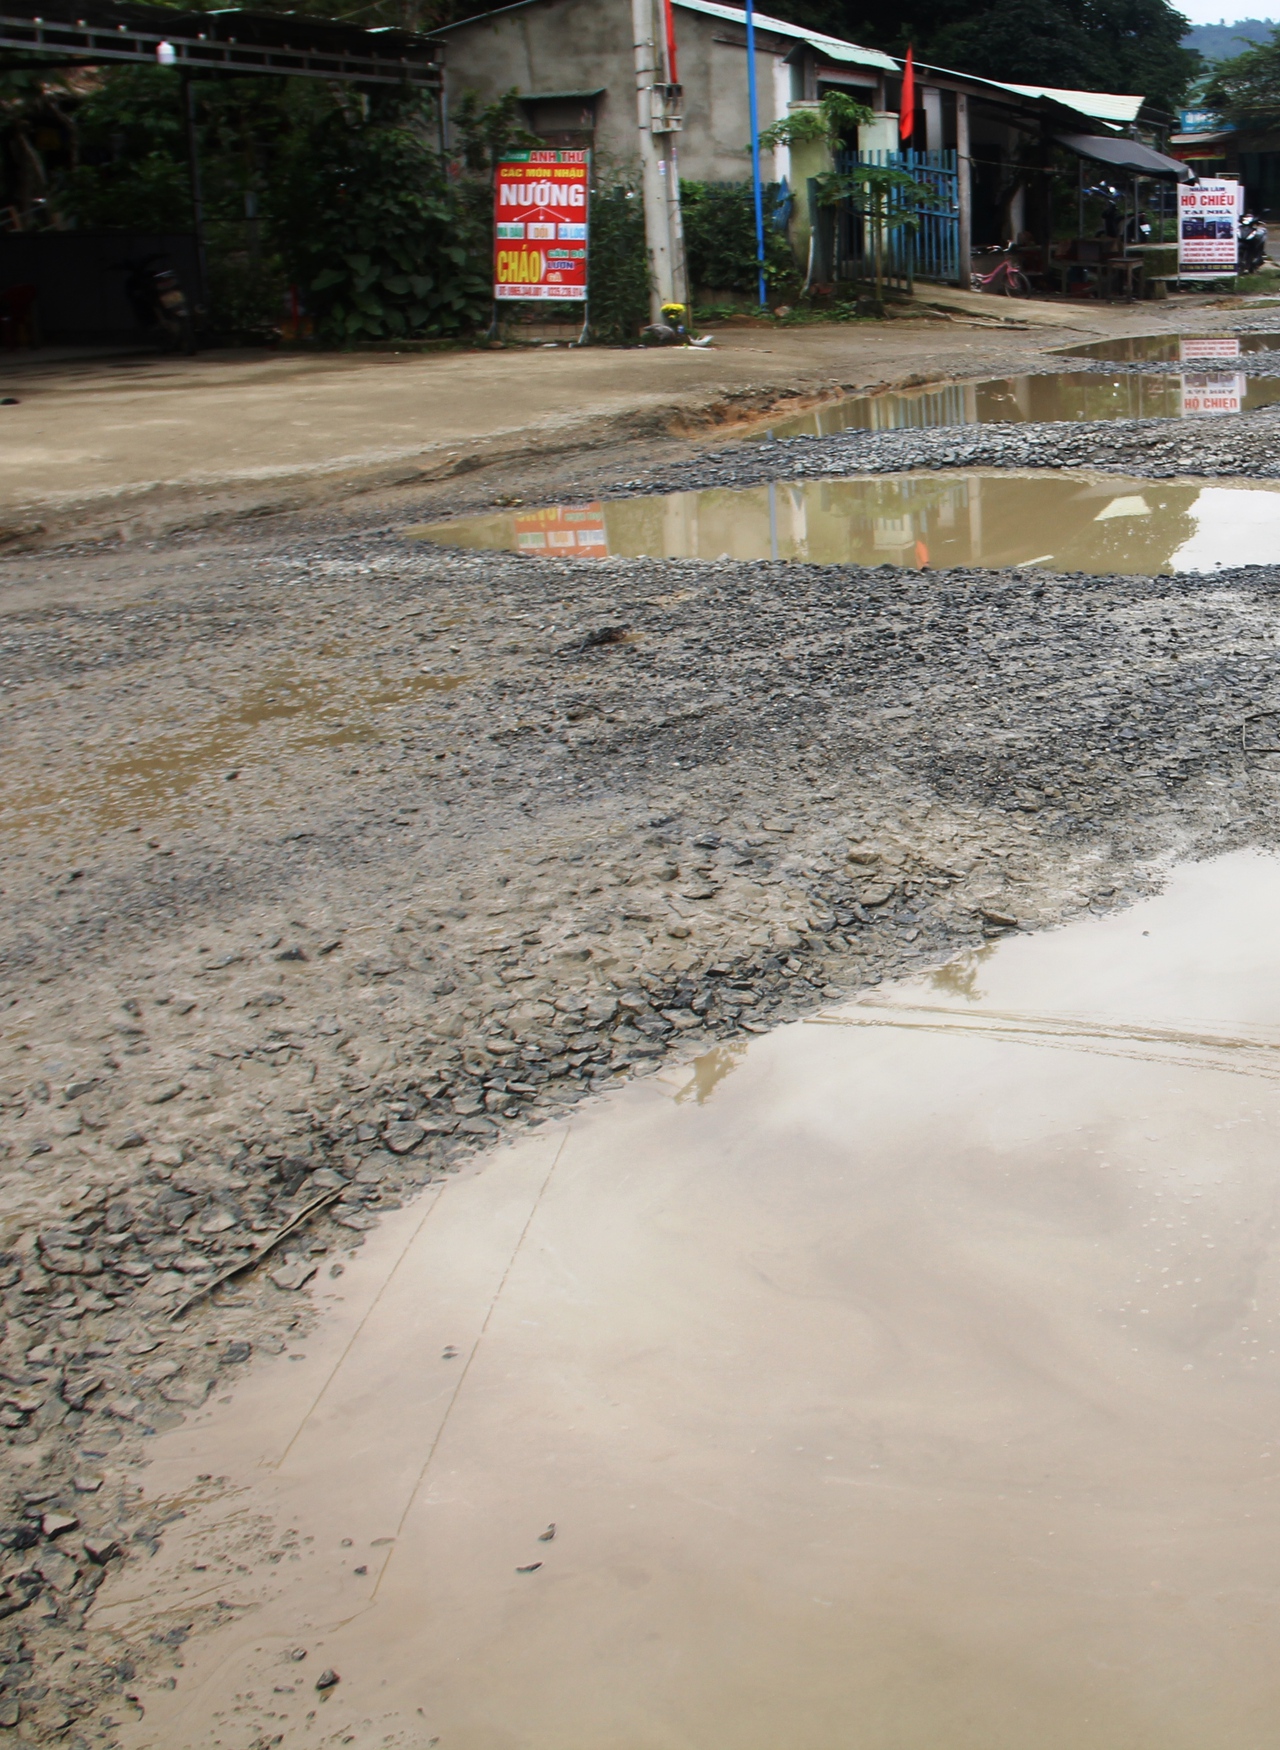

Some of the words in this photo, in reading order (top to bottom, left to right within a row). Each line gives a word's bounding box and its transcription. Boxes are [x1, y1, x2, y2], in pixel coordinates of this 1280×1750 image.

[529, 150, 557, 163] ANH
[500, 166, 523, 177] CÁC
[500, 179, 585, 207] NƯỚNG
[1181, 193, 1197, 208] HỘ
[1200, 191, 1235, 206] CHIẾU
[497, 244, 541, 283] CHÁO
